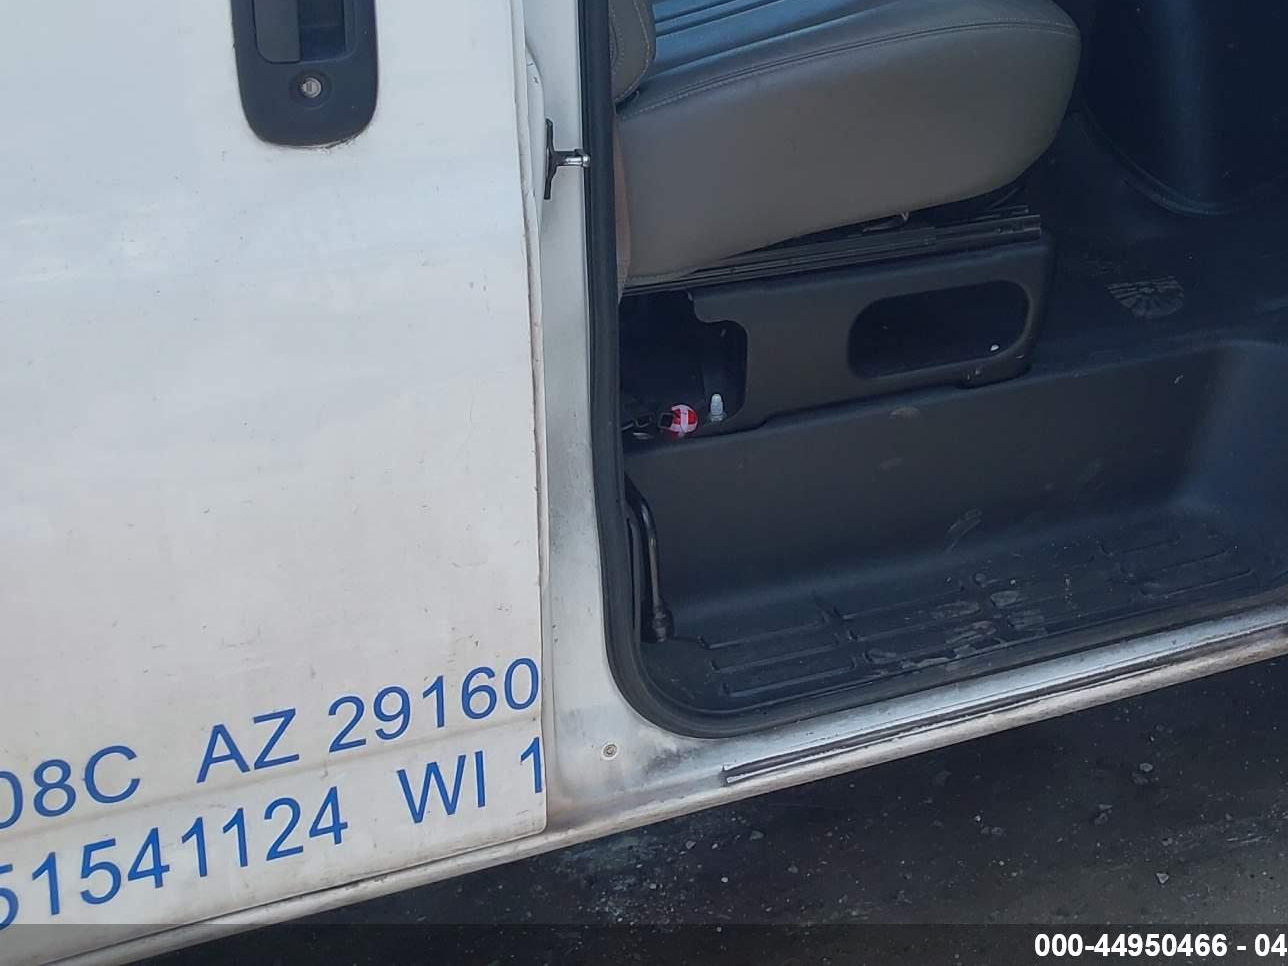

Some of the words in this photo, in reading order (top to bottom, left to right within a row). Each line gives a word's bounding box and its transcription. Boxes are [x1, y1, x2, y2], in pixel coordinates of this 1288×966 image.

[196, 708, 298, 784] AZ
[328, 657, 540, 754] 29160
[397, 749, 487, 824] WI
[519, 736, 543, 794] 1
